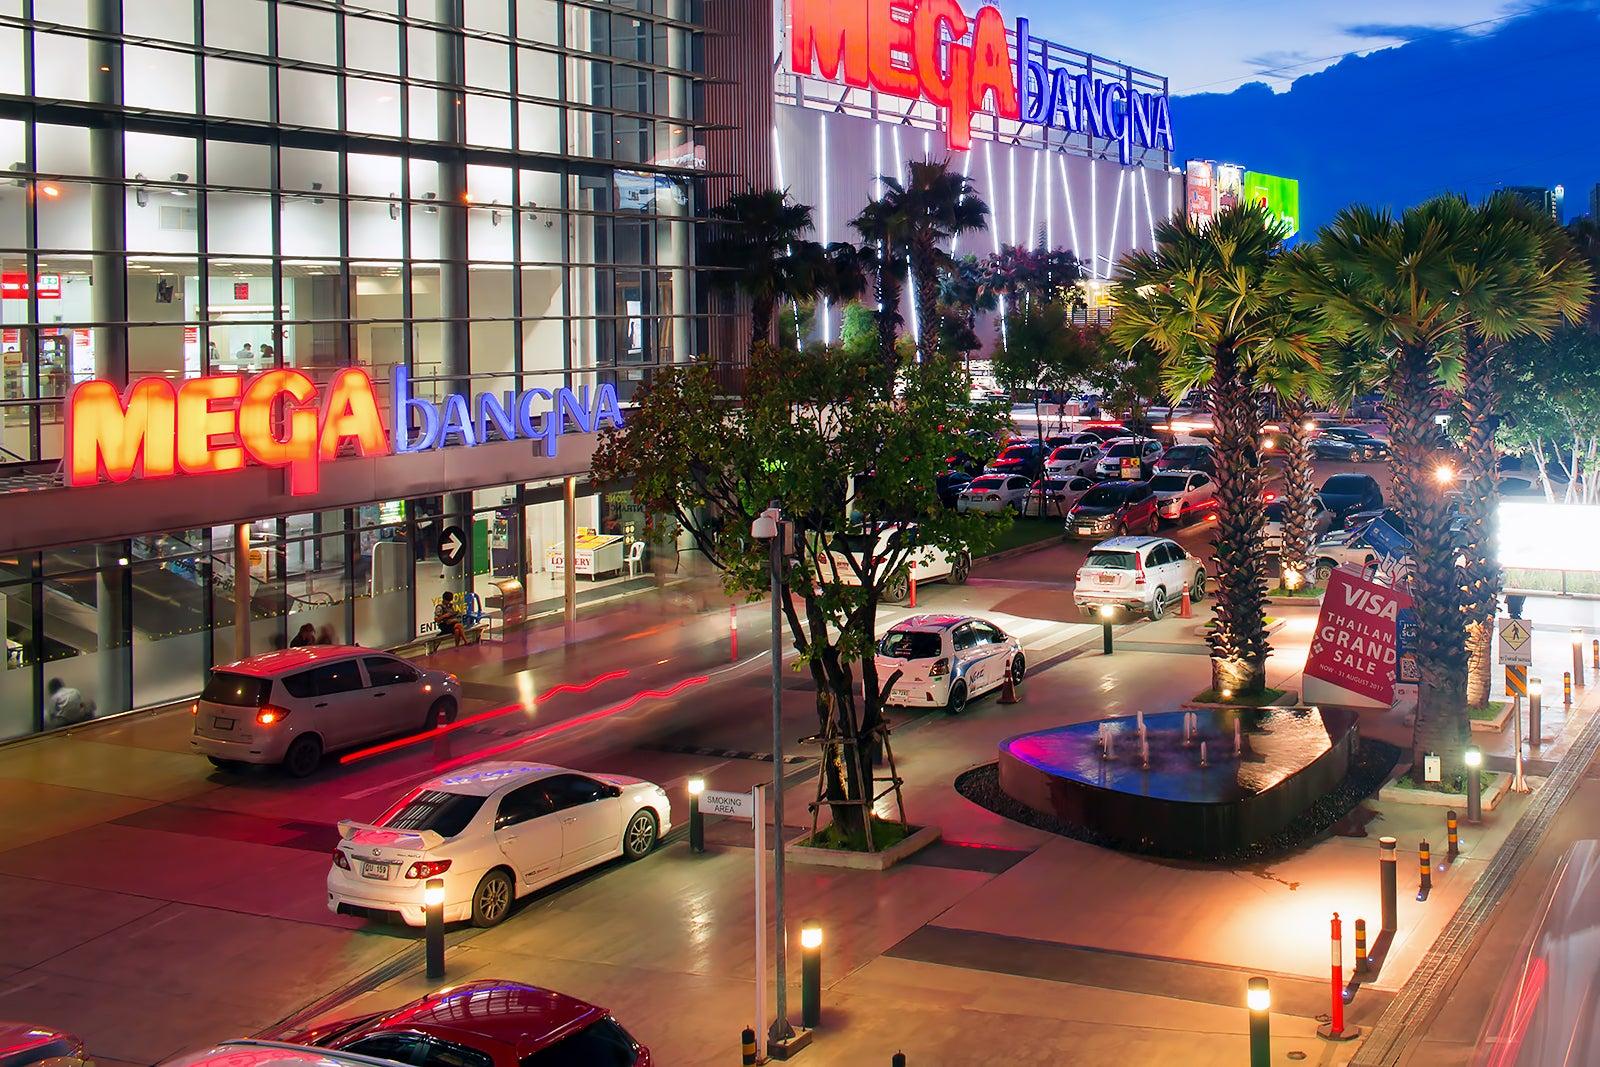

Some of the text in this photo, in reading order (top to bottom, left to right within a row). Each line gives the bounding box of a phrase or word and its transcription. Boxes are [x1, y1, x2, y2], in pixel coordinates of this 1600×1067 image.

[791, 0, 1021, 151] MEGA
[64, 367, 391, 497] MEGA
[551, 556, 591, 567] LOERY
[1341, 582, 1398, 623] VISA
[1327, 612, 1397, 646] THAILAN
[1321, 626, 1397, 665] GRAND
[1319, 664, 1334, 674] NOW
[1346, 673, 1369, 688] AUGUST
[1369, 681, 1385, 692] 2017
[1333, 649, 1377, 676] SALE
[707, 796, 742, 806] SMOKING
[714, 805, 735, 814] AREA
